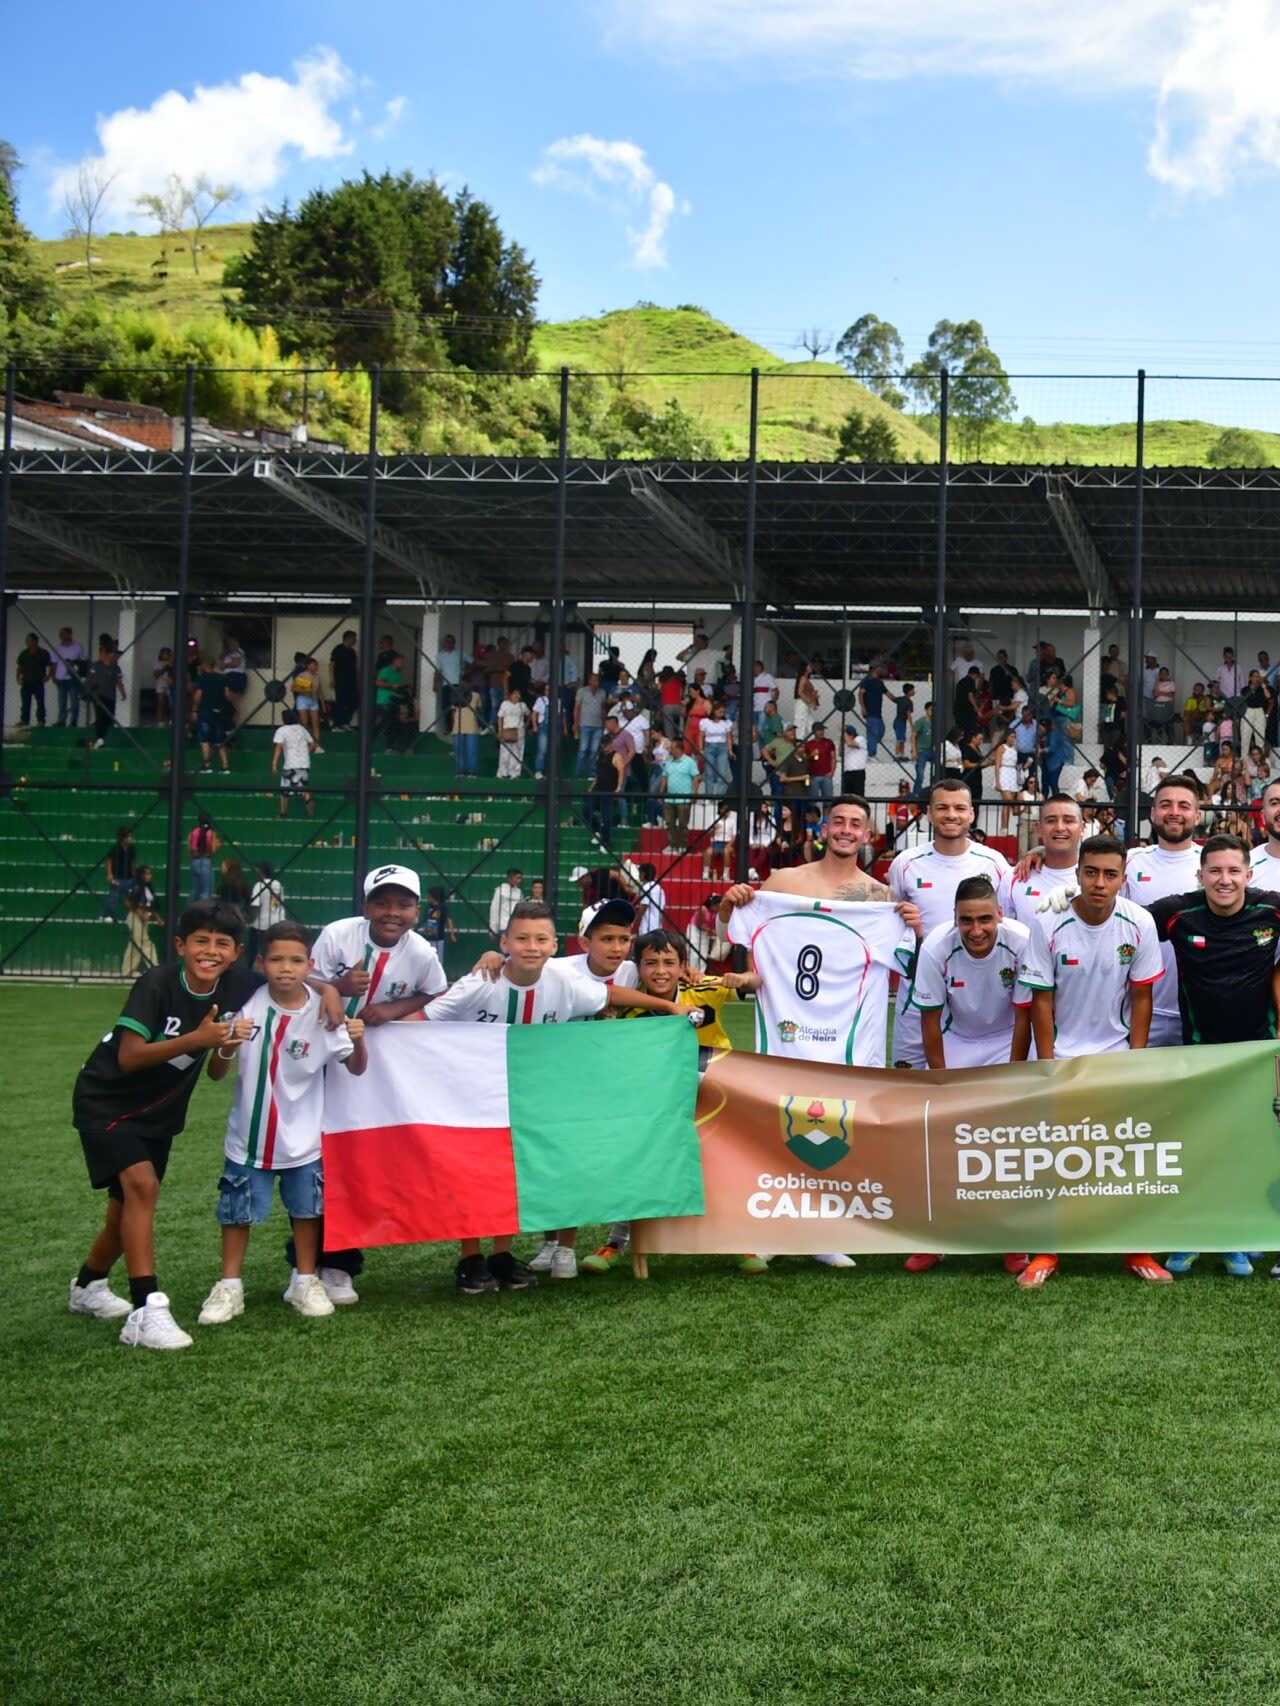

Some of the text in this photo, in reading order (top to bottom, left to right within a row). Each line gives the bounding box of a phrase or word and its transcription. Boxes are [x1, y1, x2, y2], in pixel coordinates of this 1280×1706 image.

[795, 944, 823, 1001] 8
[164, 1016, 182, 1036] 12
[477, 1010, 498, 1023] 27
[812, 1034, 837, 1042] Neira
[954, 1116, 1152, 1145] Secretaría de
[957, 1141, 1183, 1183] DEPORTE
[757, 1172, 884, 1194] Gobierno de
[956, 1185, 1043, 1200] Recreación
[1046, 1187, 1056, 1200] y
[1058, 1181, 1133, 1197] Actividad
[746, 1191, 894, 1220] CALDAS
